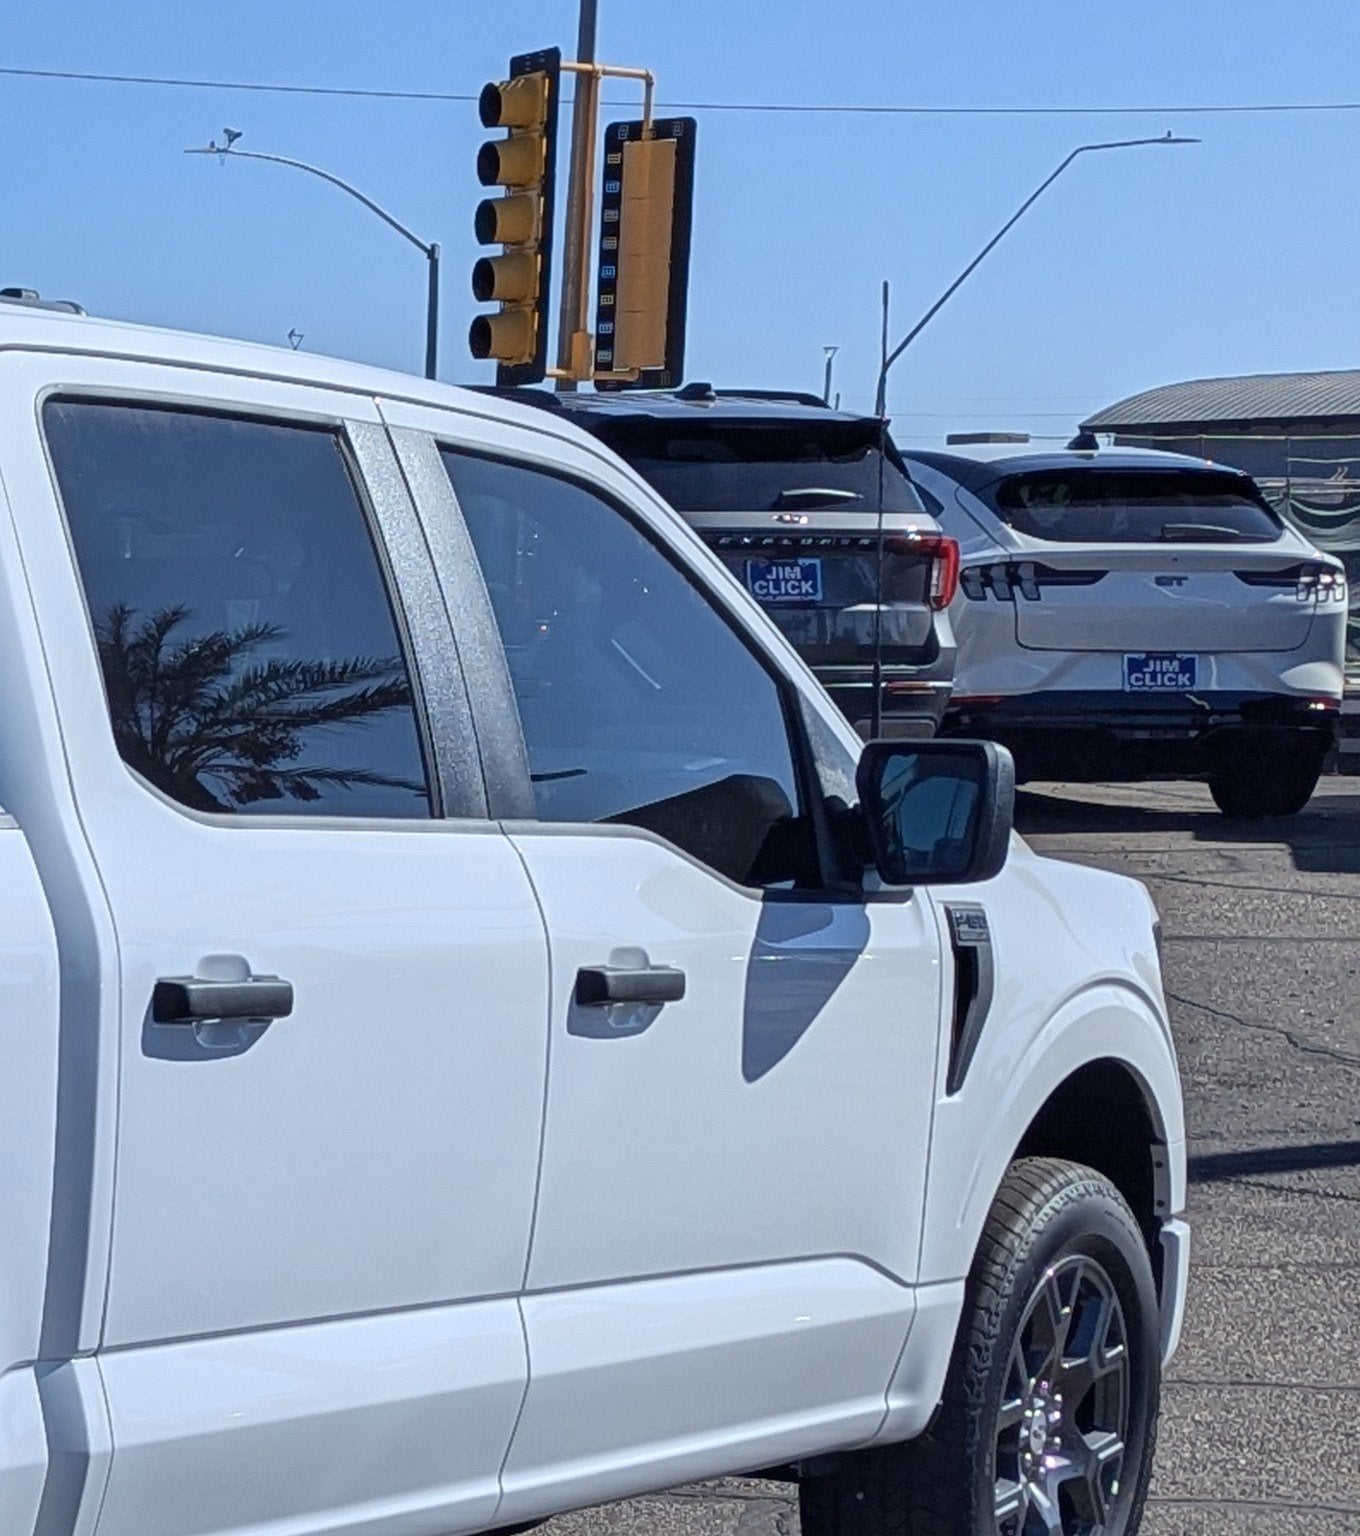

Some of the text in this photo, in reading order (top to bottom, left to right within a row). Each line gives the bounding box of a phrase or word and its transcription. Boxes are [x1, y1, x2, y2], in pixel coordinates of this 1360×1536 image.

[766, 565, 802, 580] JIM
[753, 580, 815, 595] CLICK
[1154, 575, 1189, 588] GT
[1142, 659, 1180, 673] JIM
[1129, 672, 1191, 686] CLICK
